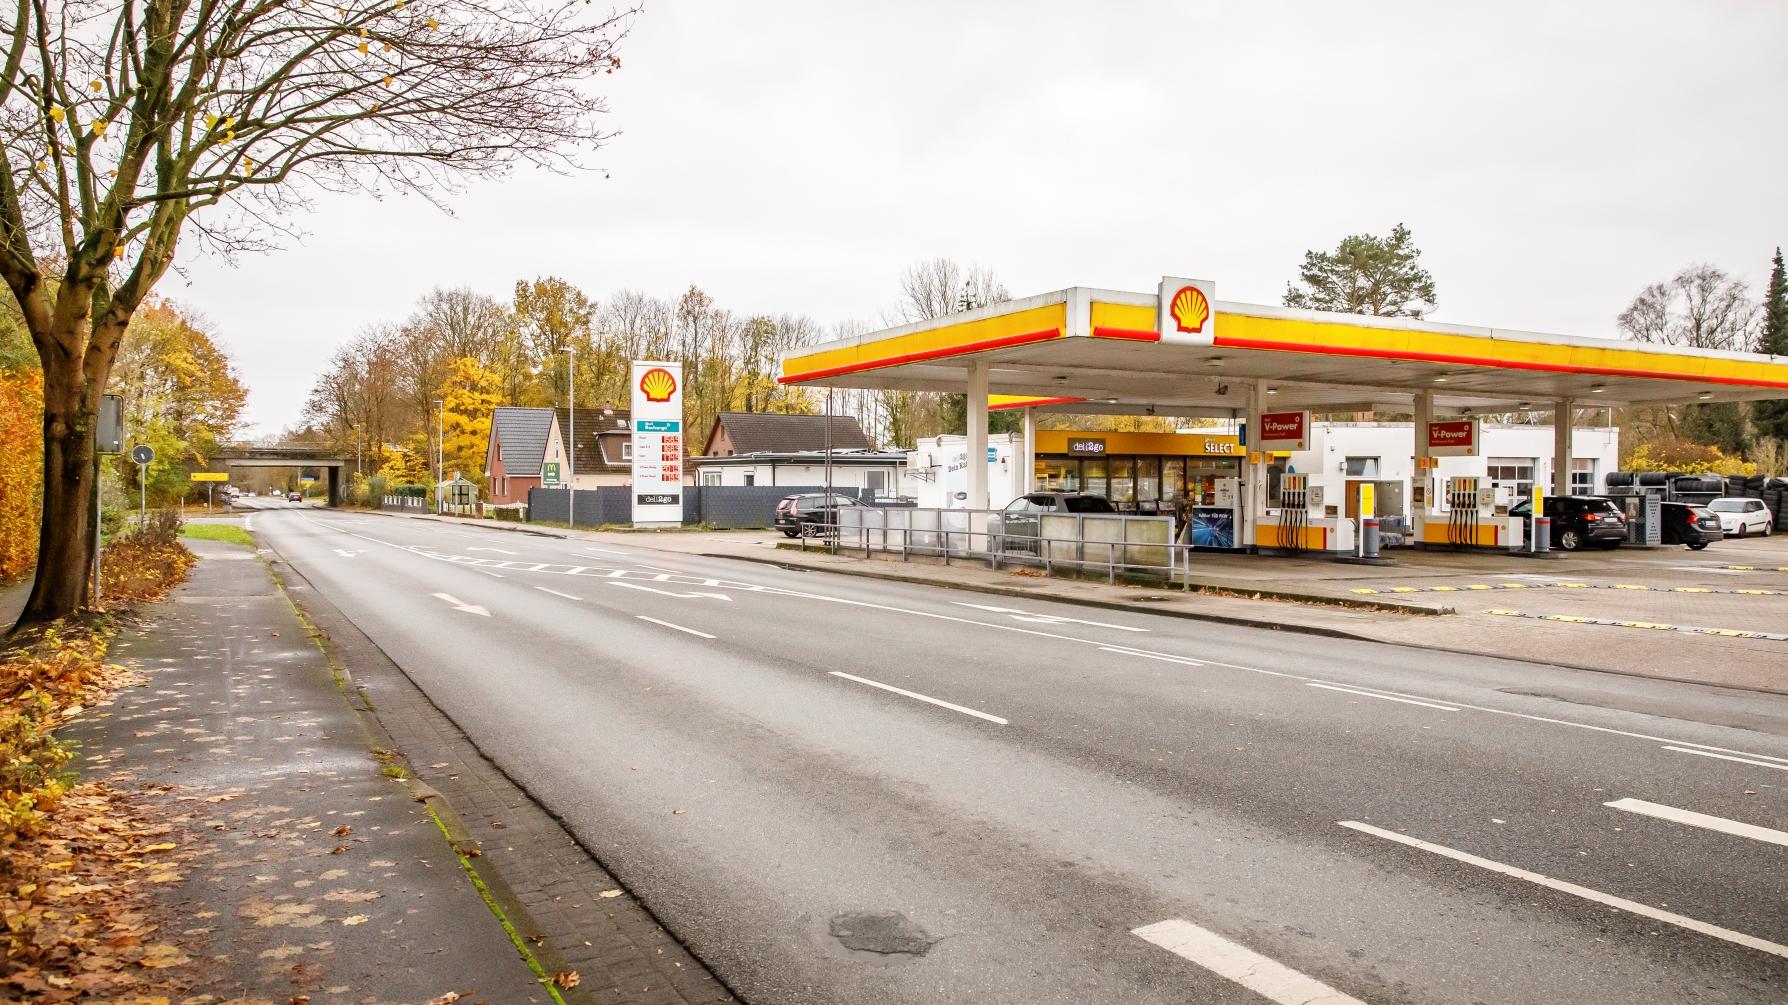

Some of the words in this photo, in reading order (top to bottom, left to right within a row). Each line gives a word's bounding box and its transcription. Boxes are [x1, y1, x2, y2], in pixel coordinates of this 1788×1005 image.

[1264, 422, 1298, 431] V-Power
[1432, 430, 1467, 438] V-Power
[1073, 441, 1104, 453] deli2go
[1204, 442, 1235, 453] SELECT
